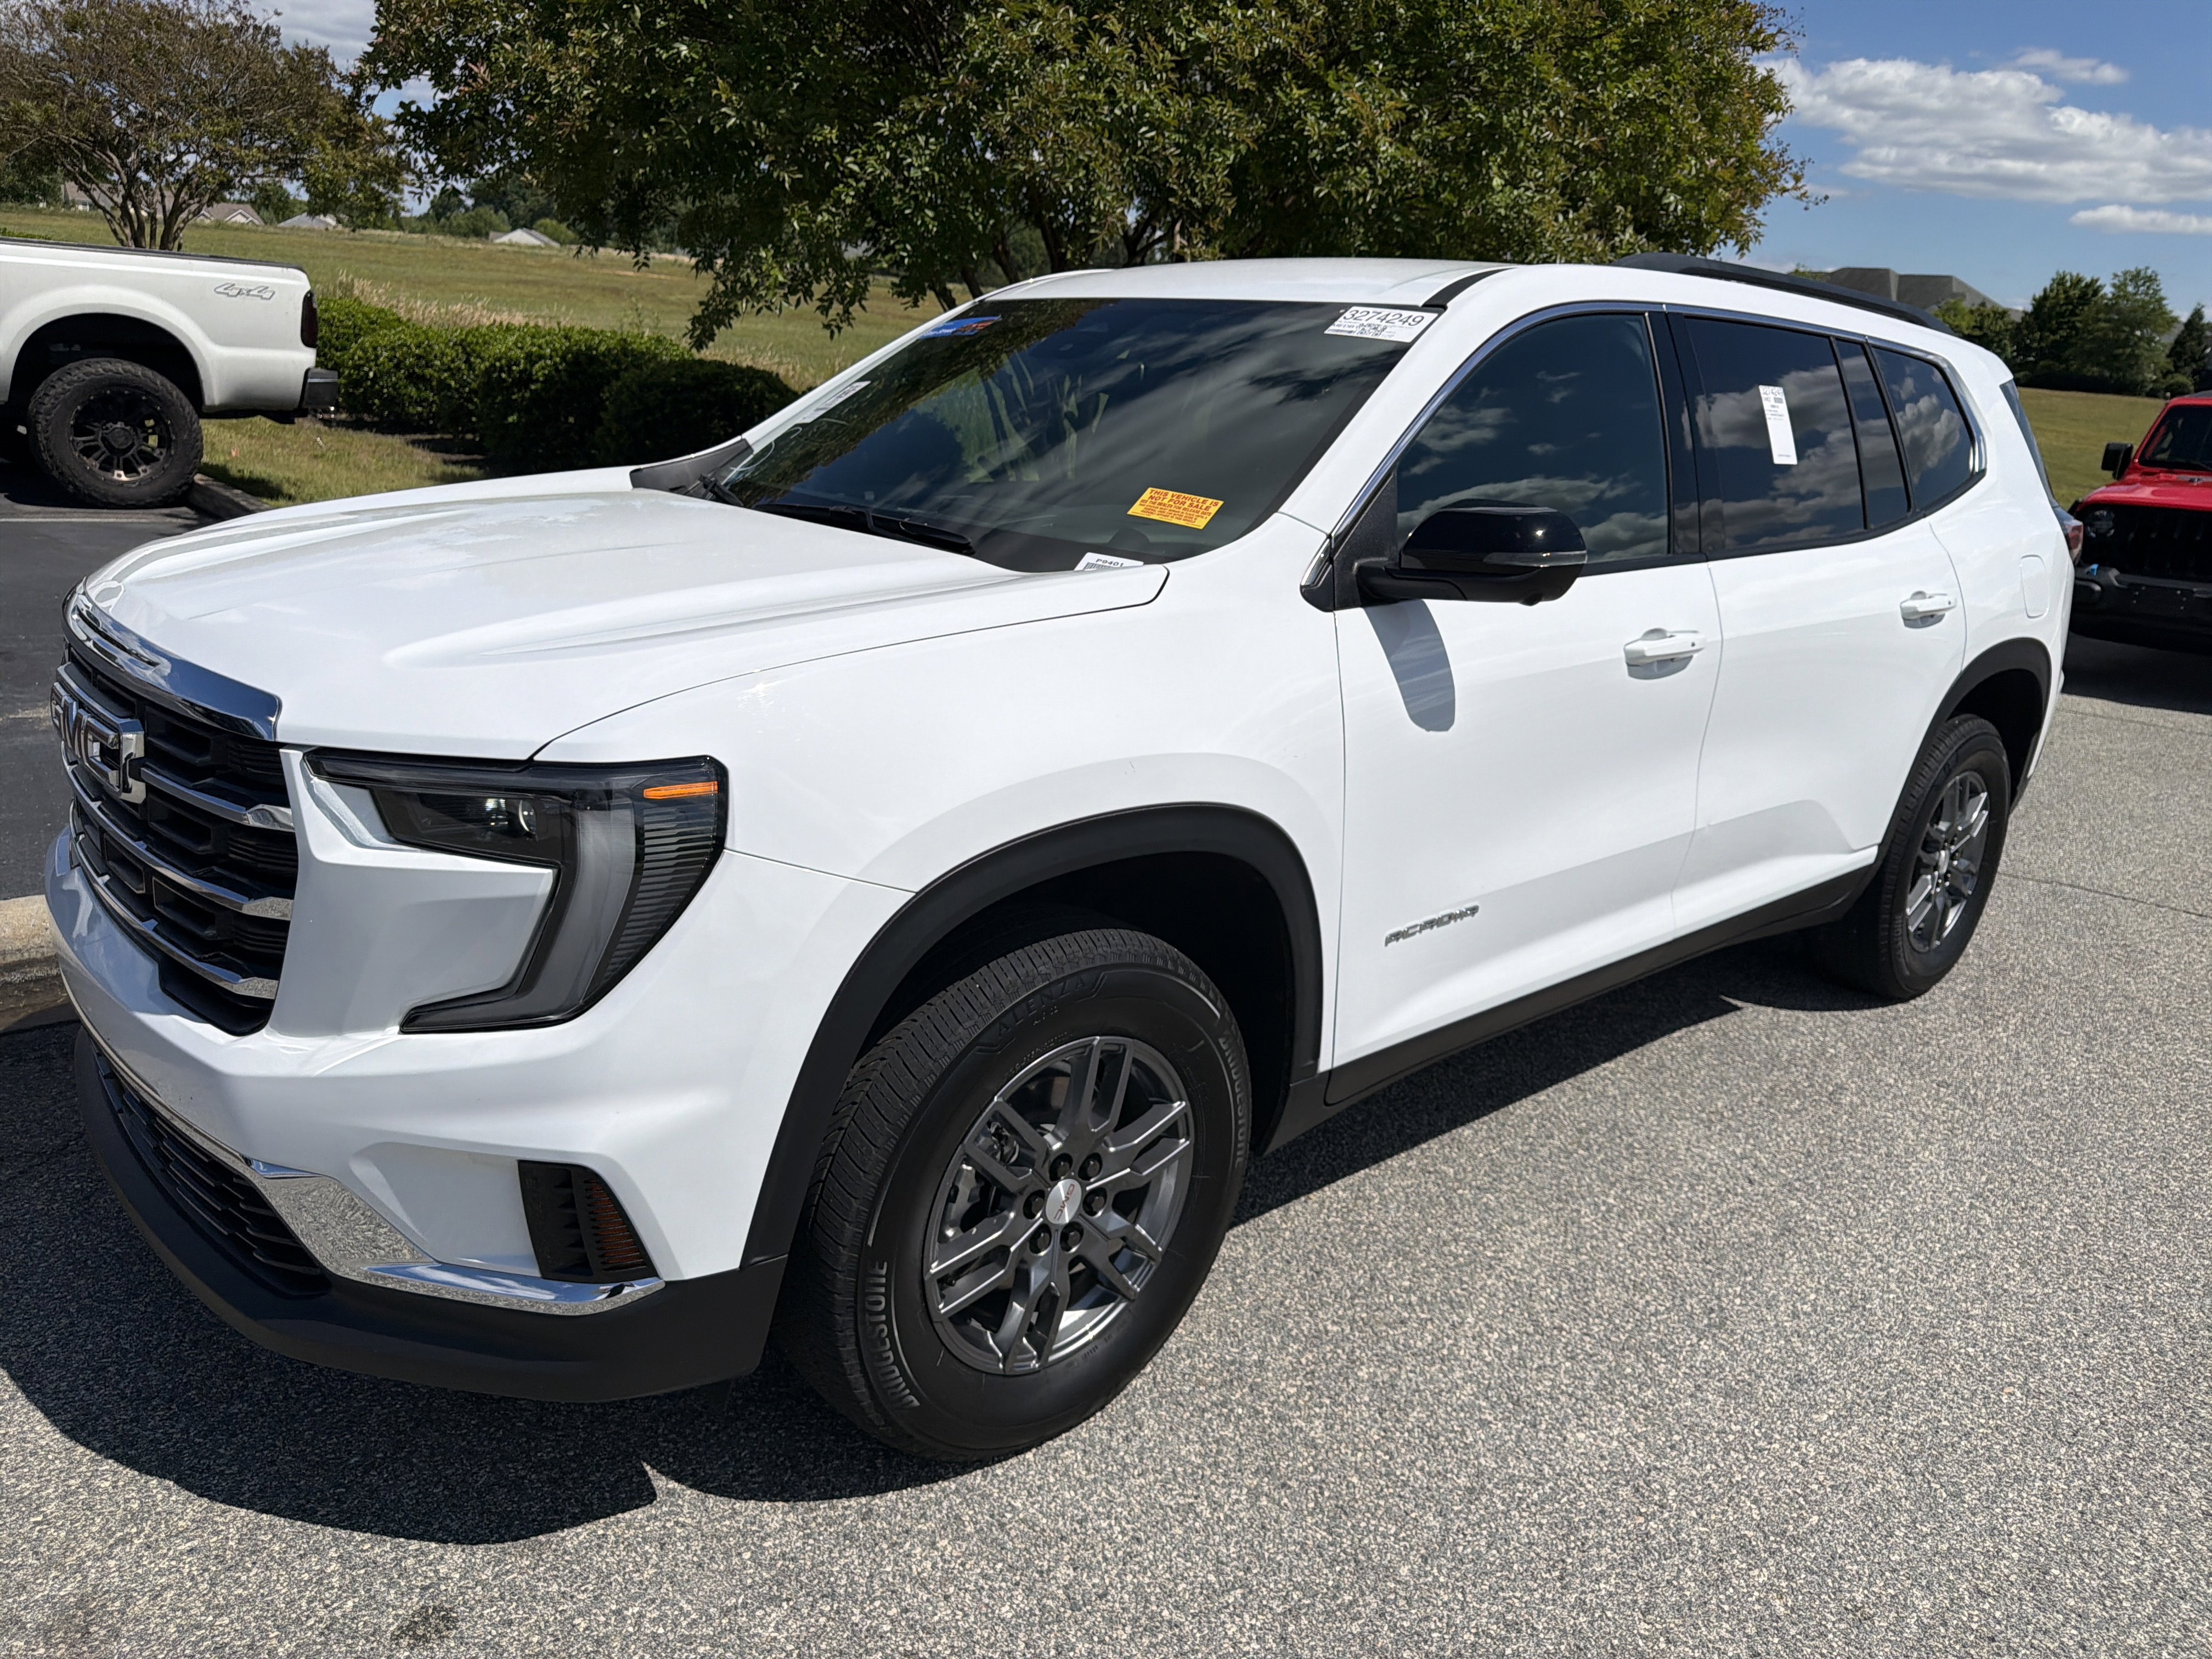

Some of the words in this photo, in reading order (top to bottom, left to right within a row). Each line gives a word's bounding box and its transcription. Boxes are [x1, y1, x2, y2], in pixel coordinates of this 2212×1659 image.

[1344, 309, 1425, 326] 3274249
[1170, 493, 1207, 504] VEHICLE
[1187, 502, 1211, 511] SALE
[1095, 558, 1124, 567] P9401
[996, 977, 1088, 1040] ALENZA
[1054, 1183, 1075, 1221] GMC
